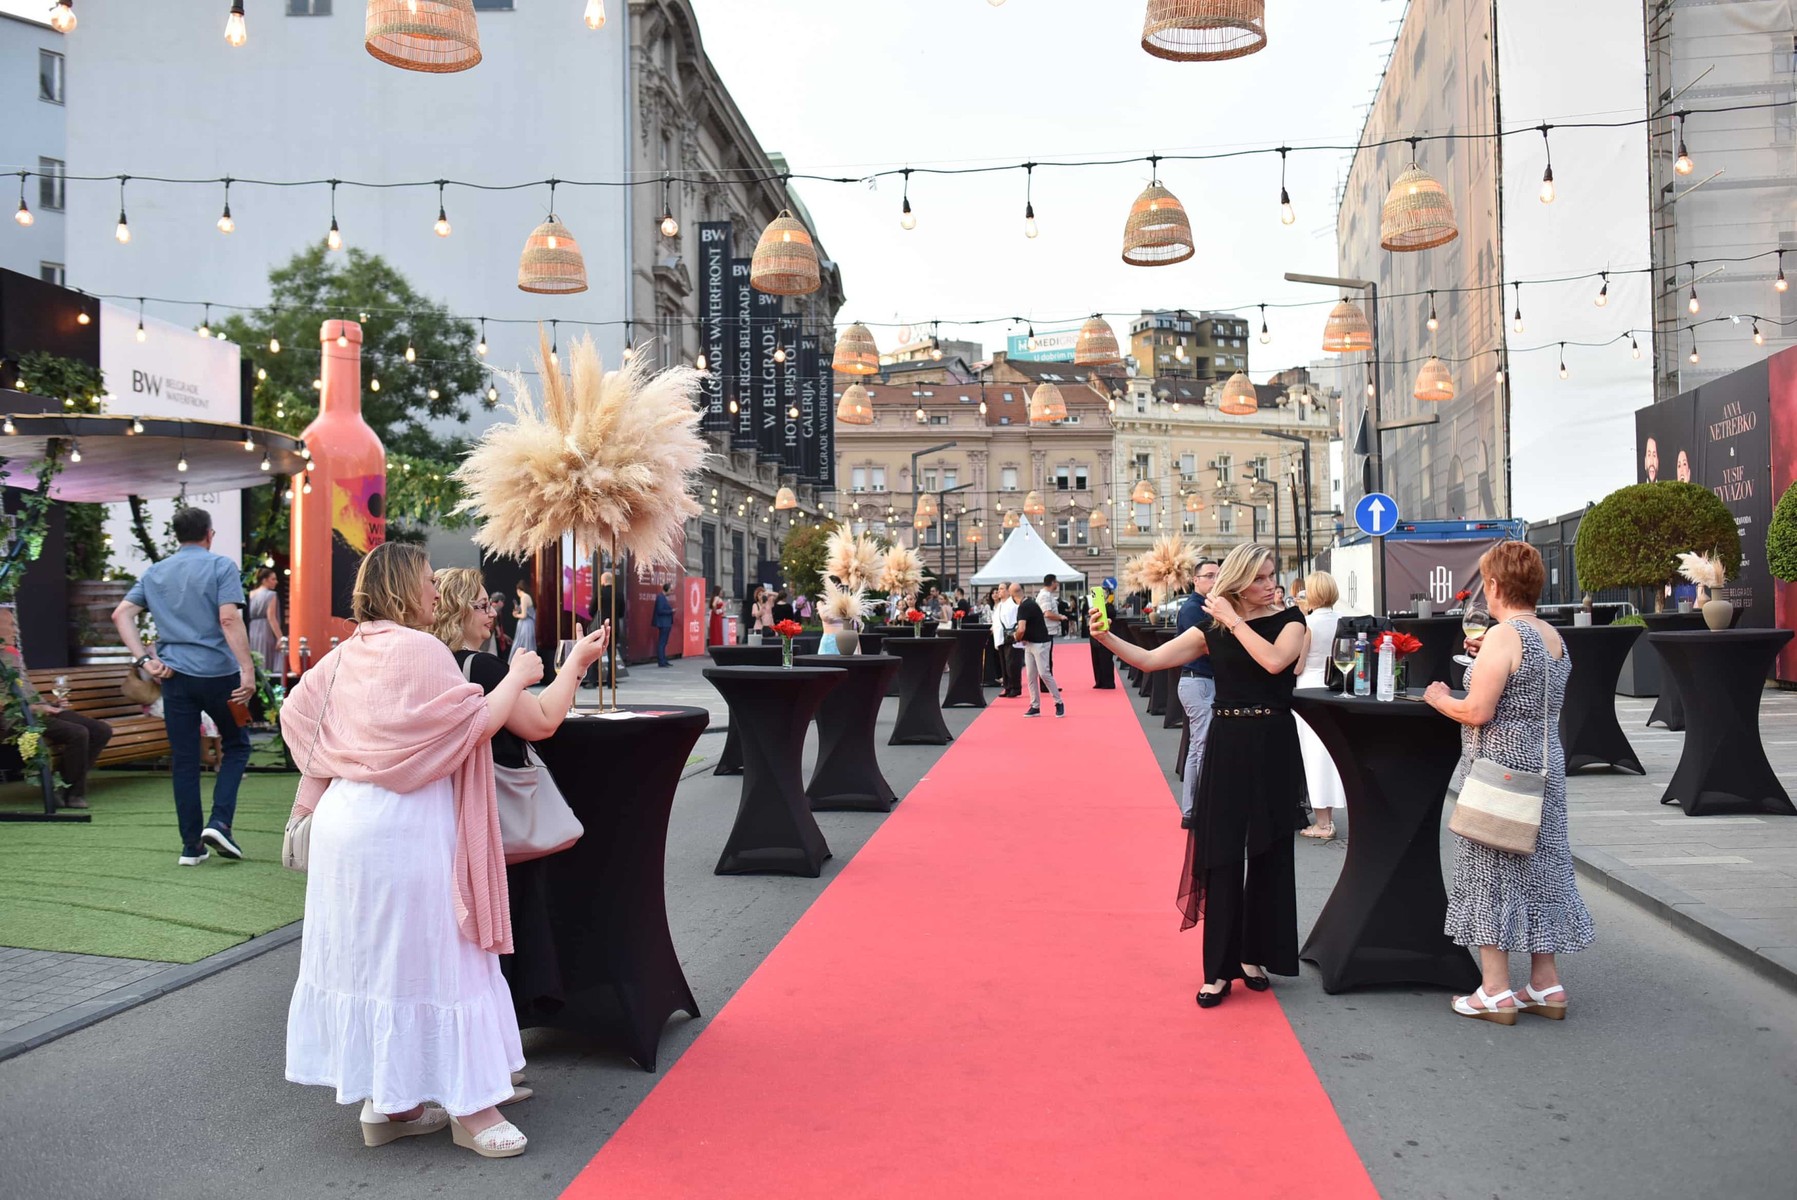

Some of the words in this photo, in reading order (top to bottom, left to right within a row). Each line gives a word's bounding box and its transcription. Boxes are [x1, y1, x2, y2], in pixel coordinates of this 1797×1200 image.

[701, 229, 727, 242] BW
[709, 247, 722, 340] WATERFRONT
[758, 295, 778, 305] BW
[739, 283, 751, 348] BELGRADE
[709, 343, 723, 414] BELGRADE
[739, 352, 751, 386] REGIS
[762, 325, 777, 407] BELGRADE
[784, 340, 797, 396] BRISTOL
[132, 369, 163, 397] BW
[740, 388, 751, 406] ST.
[801, 381, 816, 438] GALERIJA
[818, 370, 829, 432] WATERFRONT
[1723, 400, 1741, 420] ANNA
[740, 407, 751, 434] THE
[763, 412, 777, 429] W
[784, 402, 797, 447] HOTEL
[1708, 410, 1757, 442] NETREBKO
[819, 433, 829, 480] BELGRADE
[1722, 465, 1744, 484] YUSIF
[1729, 587, 1753, 597] BELGRADE
